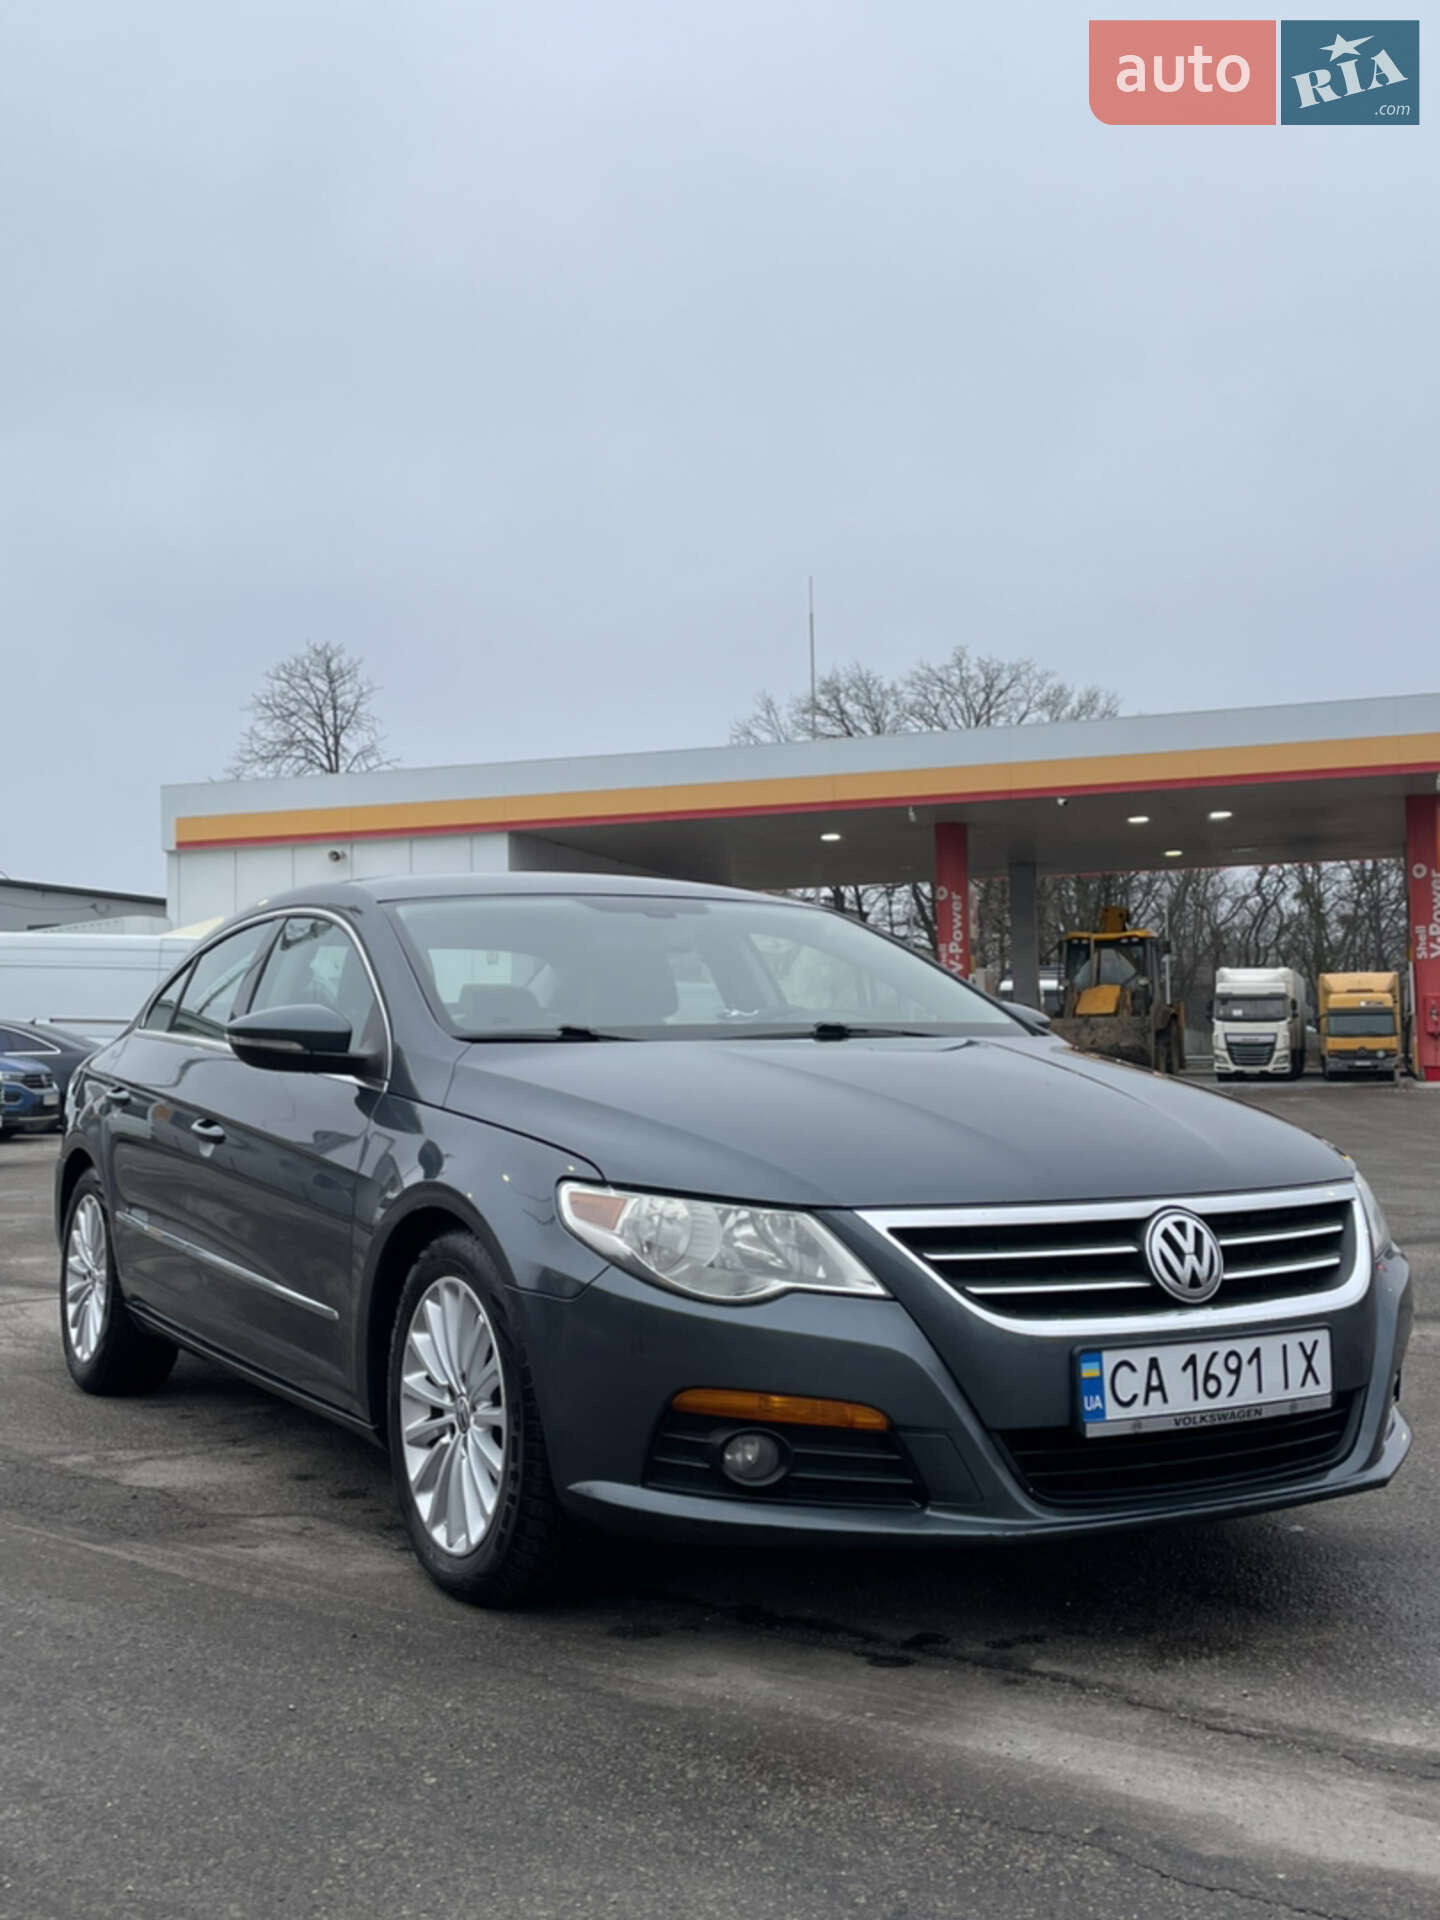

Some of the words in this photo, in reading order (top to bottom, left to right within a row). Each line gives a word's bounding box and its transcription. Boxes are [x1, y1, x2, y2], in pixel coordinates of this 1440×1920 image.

[948, 891, 964, 974] V-Power
[1415, 925, 1428, 960] Shell
[1110, 1356, 1169, 1408] CA
[1181, 1346, 1263, 1401] 1691
[1282, 1339, 1321, 1391] IX
[1084, 1395, 1104, 1412] UA
[1173, 1407, 1263, 1428] VOLKSWAGEN
